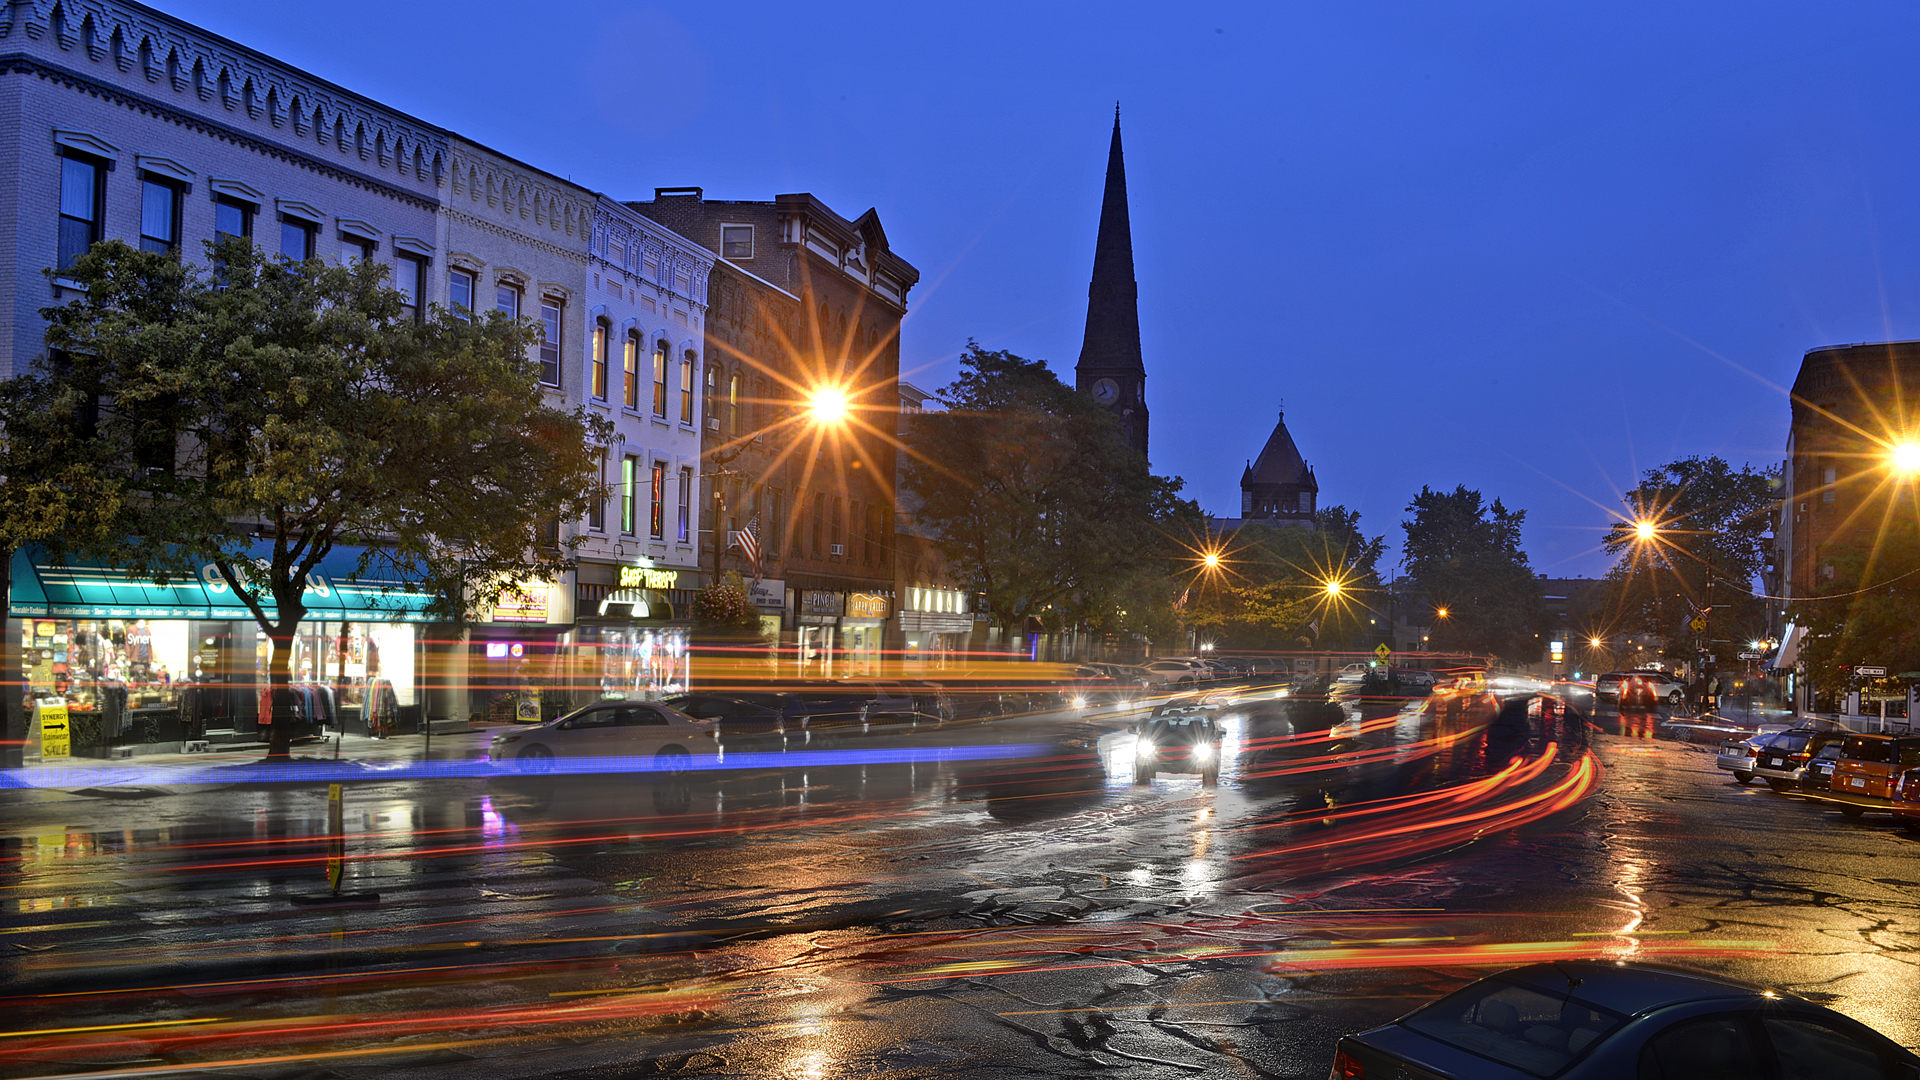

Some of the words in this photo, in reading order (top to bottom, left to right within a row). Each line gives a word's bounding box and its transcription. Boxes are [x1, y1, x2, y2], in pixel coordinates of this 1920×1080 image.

[620, 566, 643, 588] SHOP
[644, 569, 678, 590] THERAPY
[813, 593, 835, 607] PINCH
[850, 600, 868, 612] HAPPY
[868, 601, 887, 613] VALLEY
[29, 605, 48, 615] Fashions
[72, 607, 91, 616] Fashions
[94, 607, 107, 616] Shoes
[127, 632, 151, 647] Syner
[42, 713, 67, 721] SYNERGY
[43, 732, 69, 741] Rainwear
[43, 744, 69, 757] SALE
